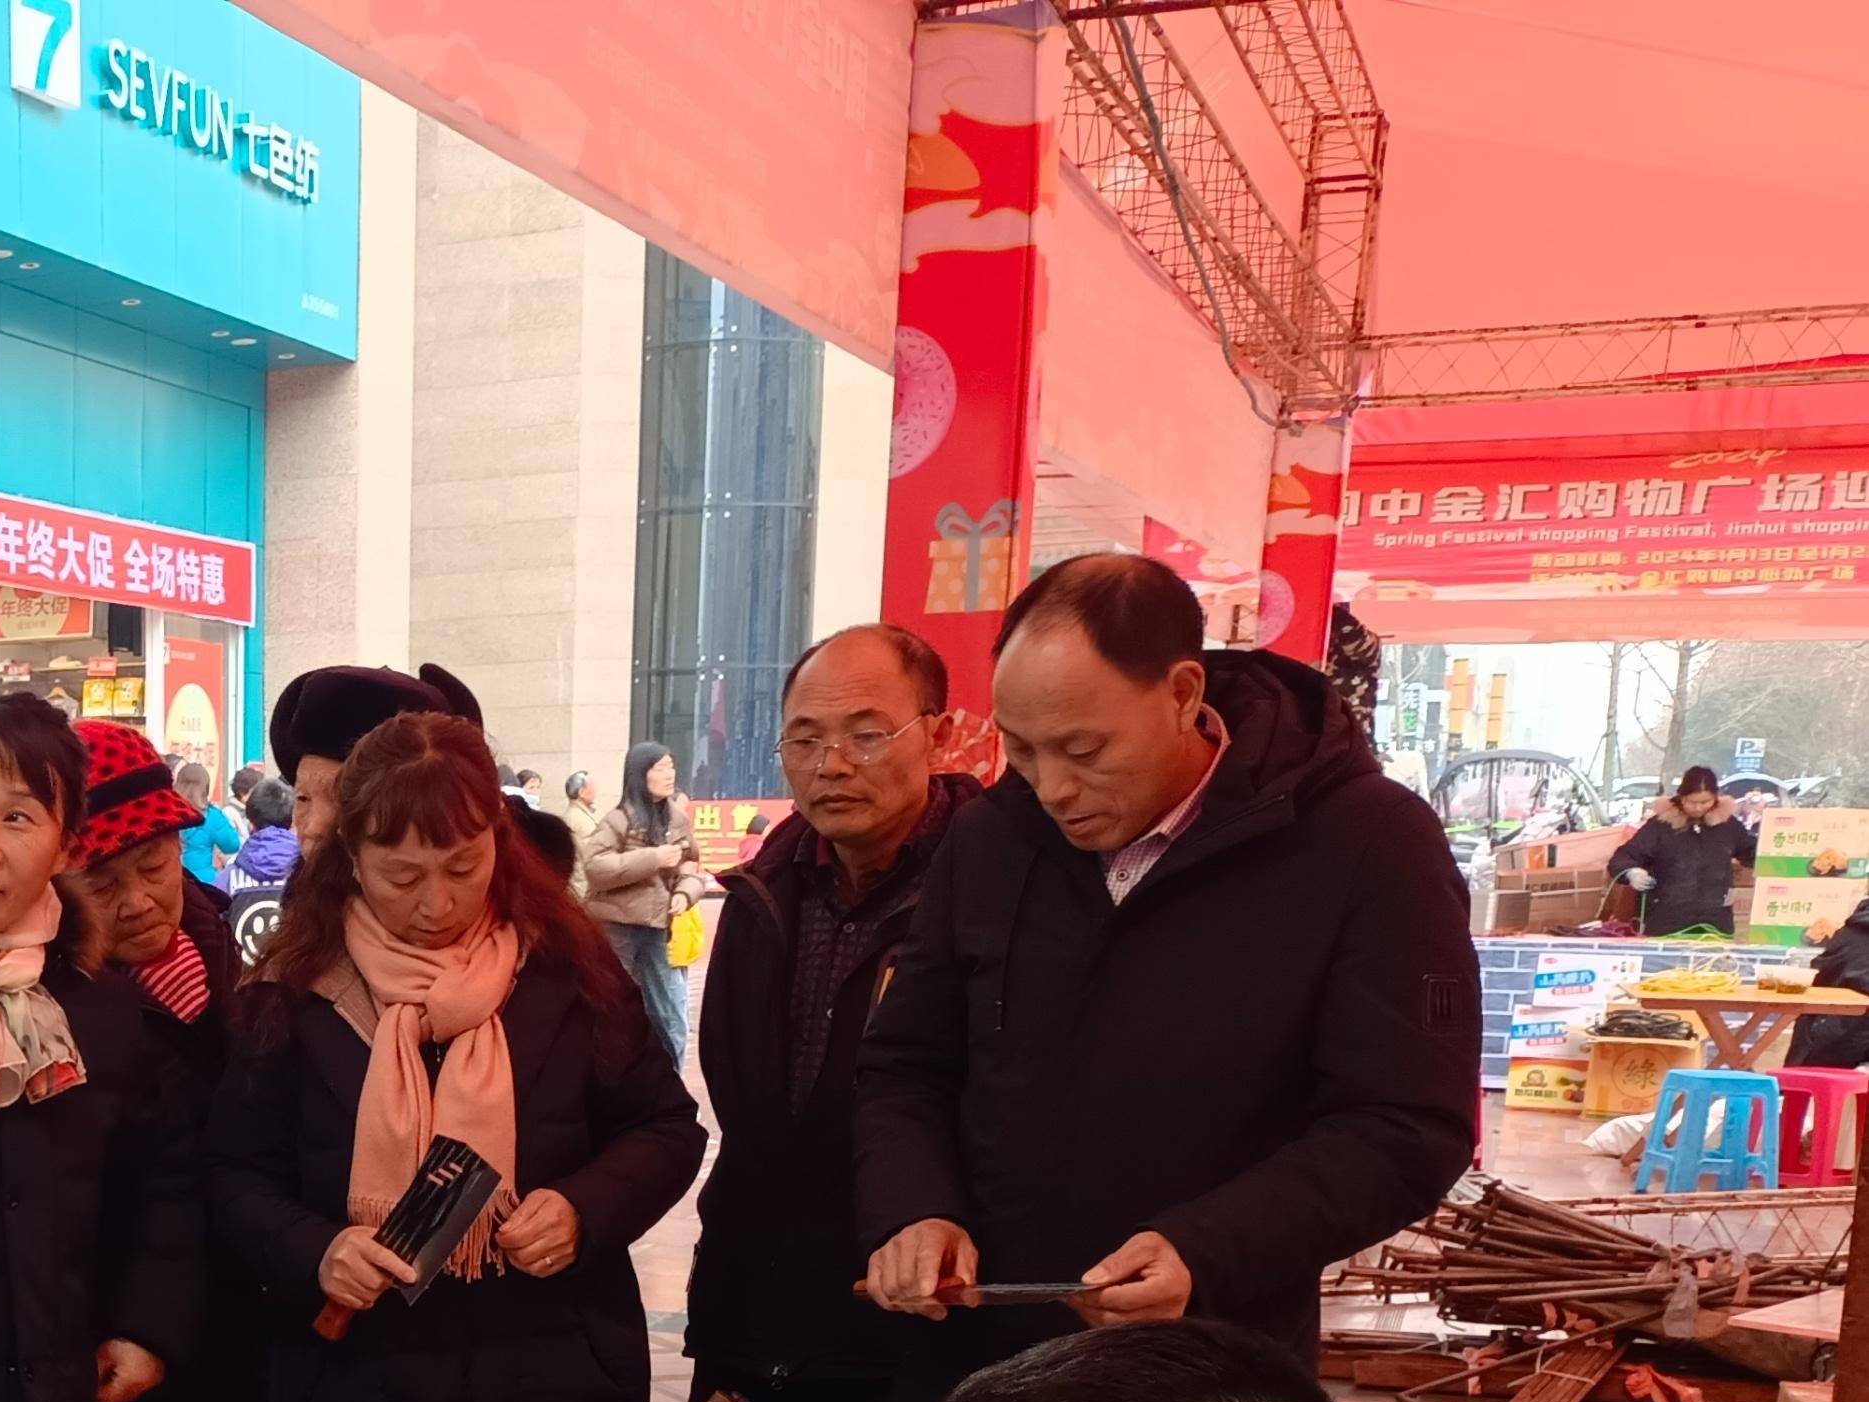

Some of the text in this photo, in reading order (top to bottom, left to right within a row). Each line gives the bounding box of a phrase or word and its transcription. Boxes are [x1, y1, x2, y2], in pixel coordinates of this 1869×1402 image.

[21, 0, 72, 92] 7
[102, 38, 320, 203] SEVFUN 七色纺
[1373, 531, 1436, 549] Spring
[1442, 527, 1524, 545] Festival
[1531, 526, 1619, 544] shopping
[1625, 522, 1718, 540] Festival,
[123, 538, 227, 606] 全场特惠
[0, 597, 67, 618] 年终大促
[1739, 740, 1755, 755] P
